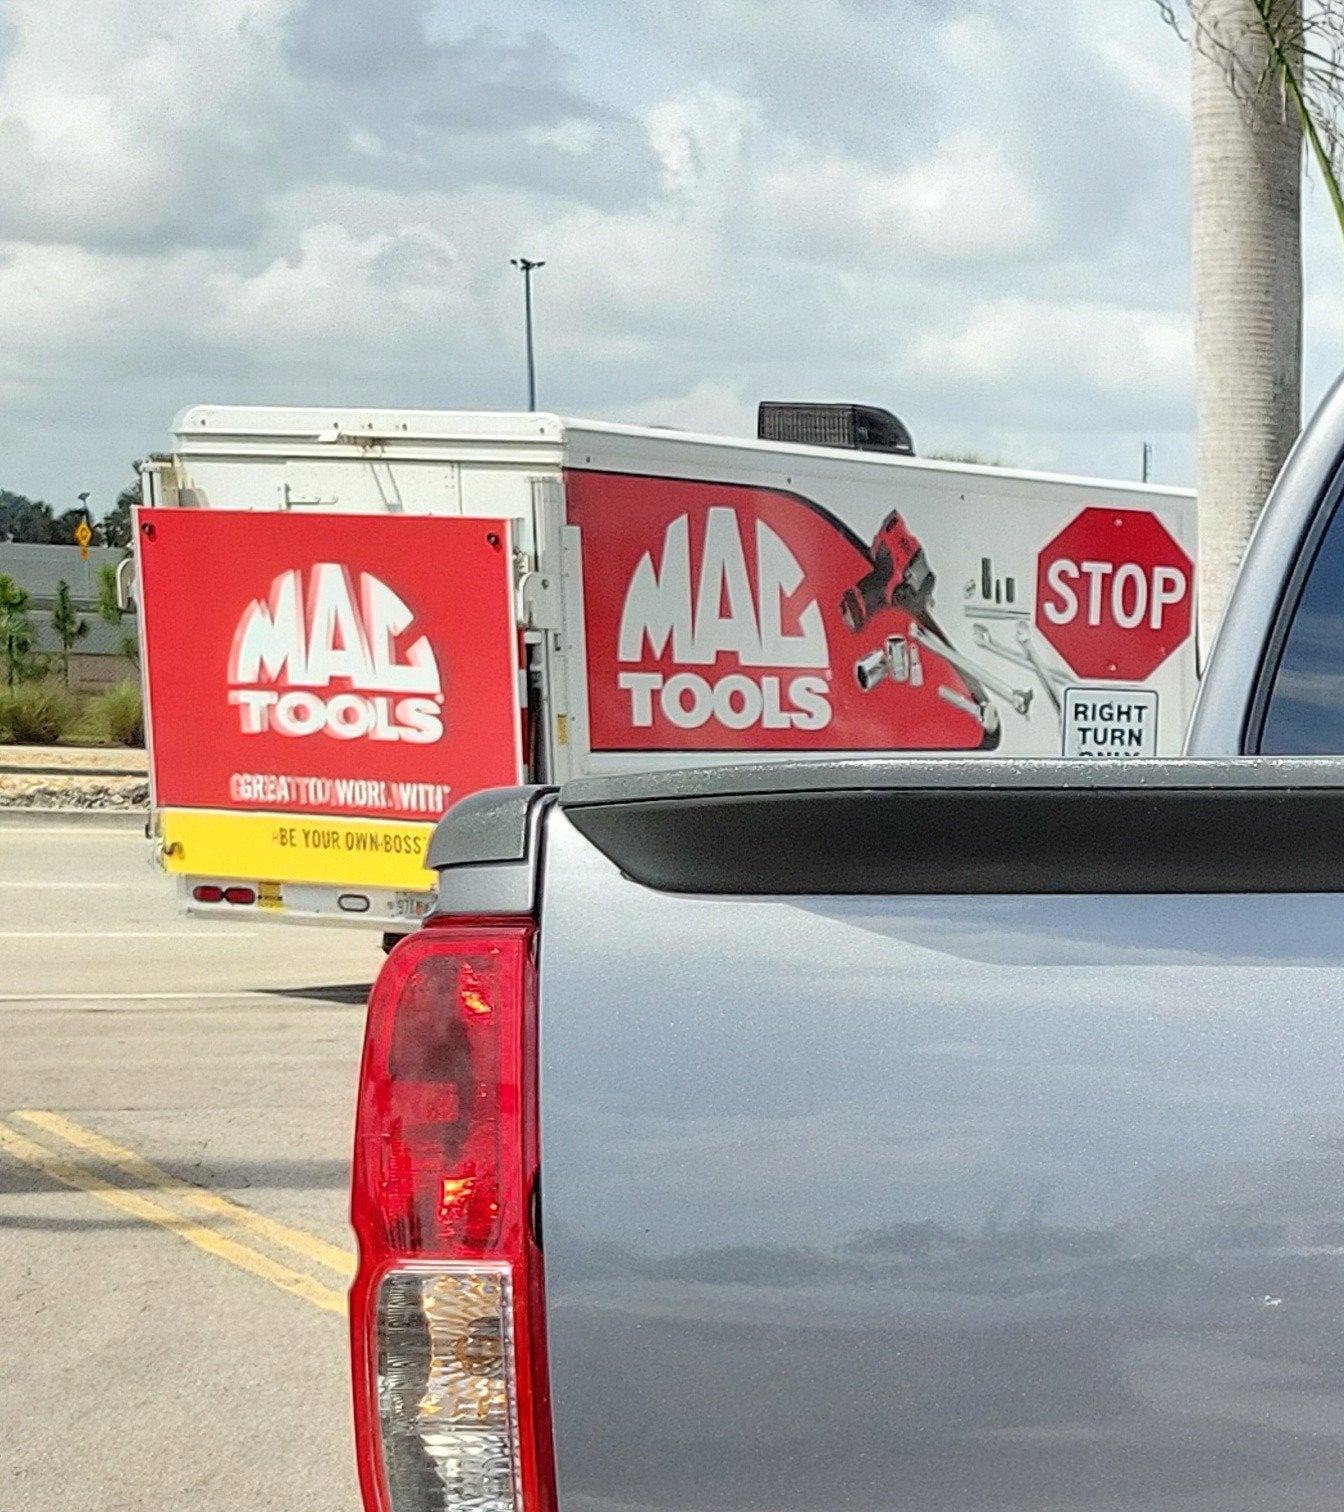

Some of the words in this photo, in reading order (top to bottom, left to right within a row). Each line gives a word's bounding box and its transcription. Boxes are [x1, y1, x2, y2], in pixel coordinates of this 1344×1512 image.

[618, 506, 830, 669] MAC
[1044, 558, 1187, 630] STOP
[228, 563, 442, 694] MAC
[228, 689, 444, 744] TOOLS
[618, 671, 832, 730] TOOLS
[1074, 703, 1148, 723] RIGHT
[1077, 727, 1142, 746] TURN
[302, 829, 340, 849] YOUR
